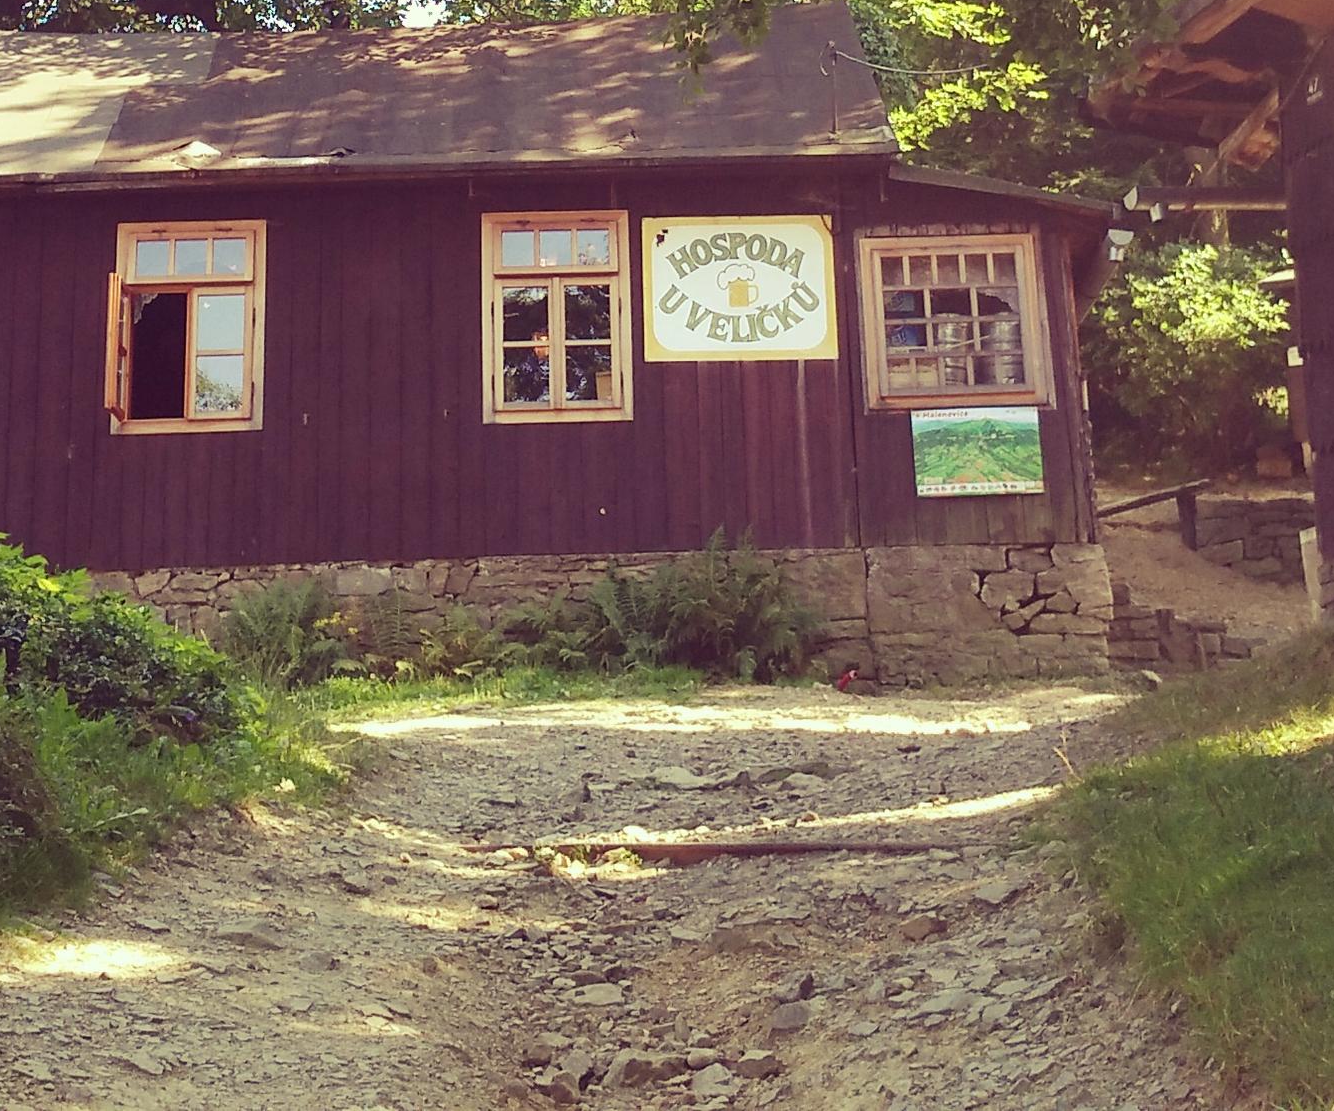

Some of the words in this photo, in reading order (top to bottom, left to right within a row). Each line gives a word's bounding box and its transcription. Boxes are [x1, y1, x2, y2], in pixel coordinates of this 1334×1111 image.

[665, 232, 806, 280] HOSPODA
[658, 283, 689, 315] U
[685, 280, 820, 343] VELIČKŮ
